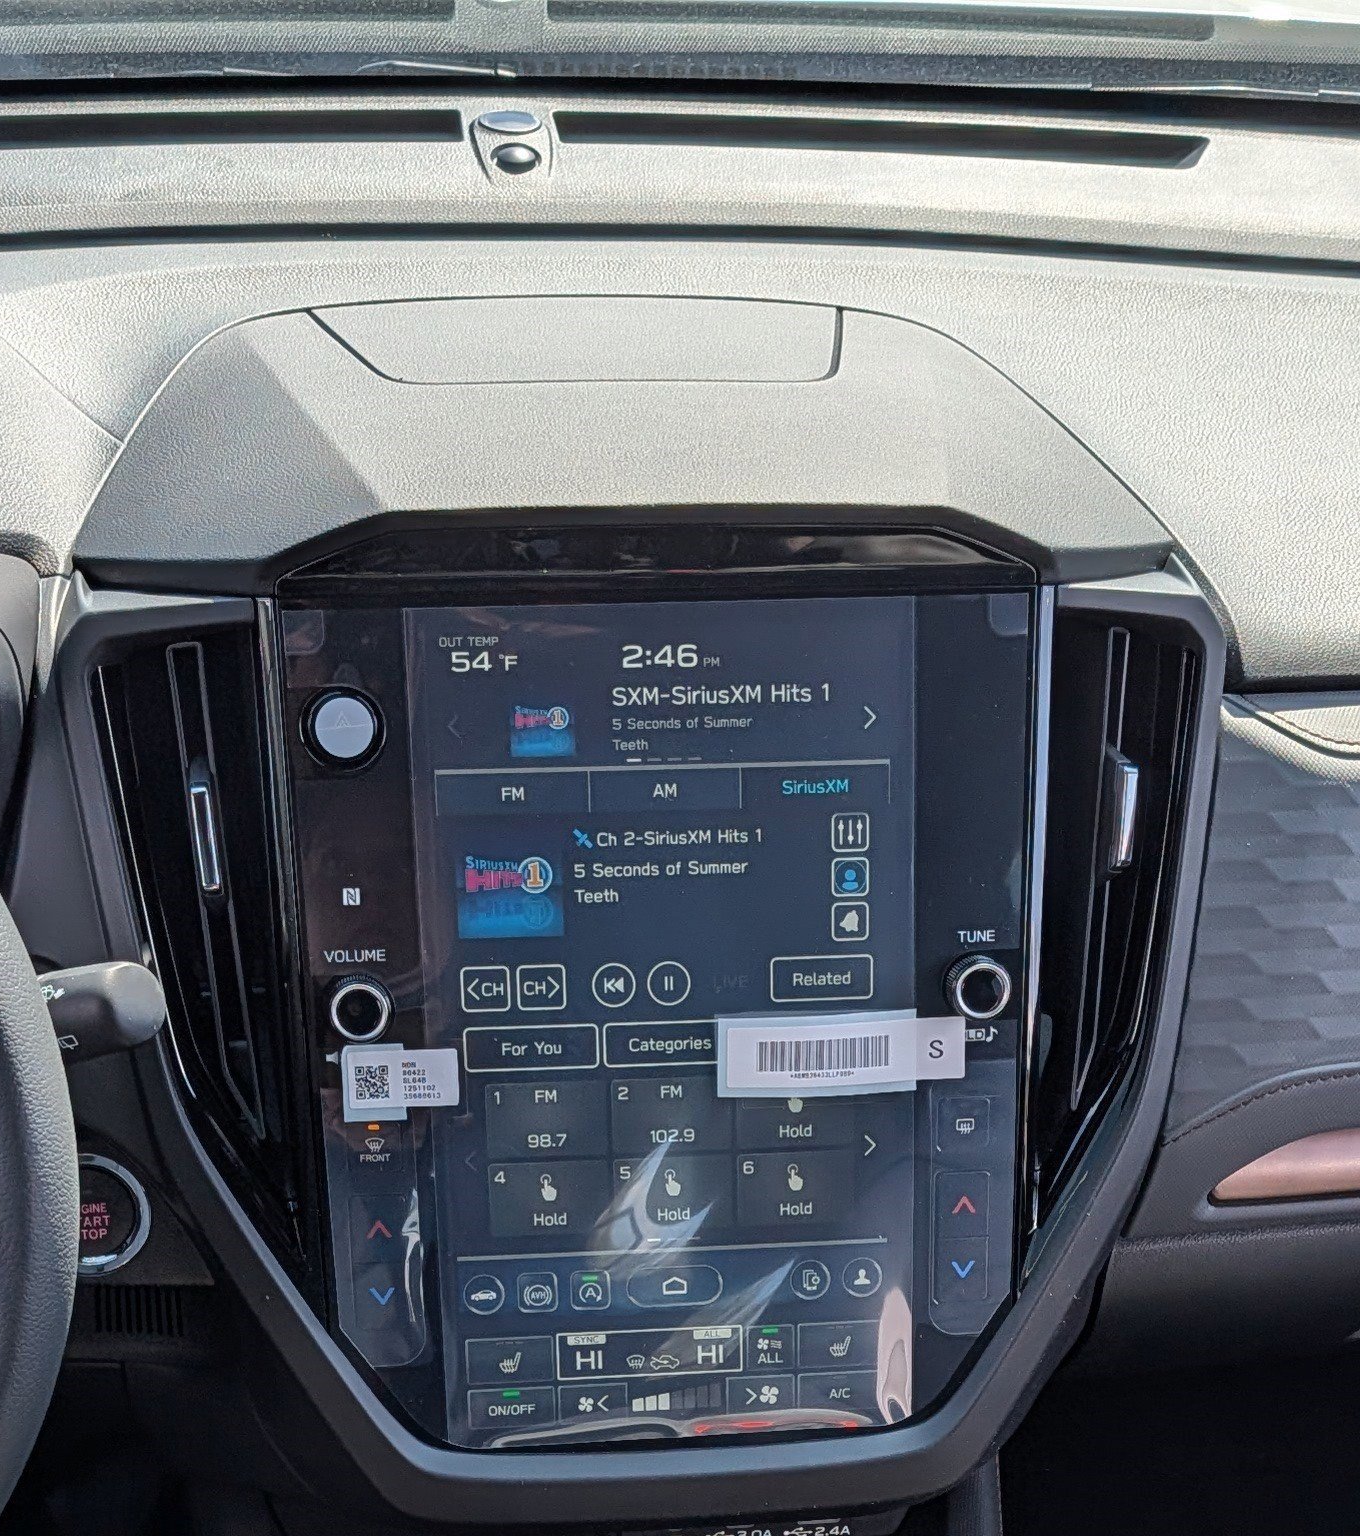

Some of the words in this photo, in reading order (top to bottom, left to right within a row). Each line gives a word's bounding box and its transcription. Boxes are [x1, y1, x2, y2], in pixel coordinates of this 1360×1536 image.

[439, 637, 464, 647] OUT
[467, 636, 499, 647] TEMP
[451, 652, 492, 672] 54
[622, 644, 698, 669] 2:46
[703, 657, 720, 667] PM
[612, 685, 762, 706] SXM-SiriusXM
[771, 684, 812, 703] Hits
[822, 683, 830, 701] 1
[612, 719, 621, 730] 5
[627, 718, 681, 730] Seconds
[687, 717, 699, 729] of
[704, 716, 753, 728] Summer
[612, 739, 649, 751] Teeth
[501, 787, 525, 801] FM
[653, 784, 677, 798] AM
[782, 779, 849, 795] SiriusXM
[597, 832, 617, 846] Ch
[624, 830, 711, 846] 2-SiriusXM
[718, 829, 748, 843] Hits
[755, 829, 762, 842] 1
[574, 864, 585, 878] 5
[593, 862, 659, 877] Seconds
[666, 861, 682, 875] of
[688, 860, 748, 875] Summer
[574, 889, 619, 903] Teeth
[957, 930, 996, 942] TUNE
[323, 949, 386, 963] VOLUME
[793, 972, 851, 987] Related
[502, 1043, 525, 1057] For
[534, 1041, 562, 1055] You
[629, 1036, 712, 1054] Categories
[929, 1040, 944, 1059] S
[494, 1091, 501, 1105] 1
[534, 1090, 558, 1103] FM
[617, 1087, 629, 1100] 2
[660, 1085, 683, 1098] FM
[650, 1129, 695, 1143] 102.9
[779, 1124, 813, 1138] Hold
[528, 1134, 567, 1148] 98.7
[360, 1153, 391, 1163] FRONT
[620, 1167, 631, 1180] 5
[743, 1161, 754, 1174] 6
[494, 1172, 506, 1183] 4
[81, 1203, 107, 1214] GINE
[657, 1207, 690, 1221] Hold
[780, 1202, 813, 1216] Hold
[81, 1215, 110, 1227] ART
[533, 1213, 567, 1226] Hold
[81, 1229, 108, 1240] TOP
[573, 1336, 600, 1344] SYNC
[704, 1330, 720, 1338] ALL
[576, 1350, 603, 1370] HI
[697, 1344, 724, 1364] HI
[757, 1352, 783, 1365] ALL
[830, 1387, 850, 1399] A/C
[488, 1403, 536, 1416] ON/OFF
